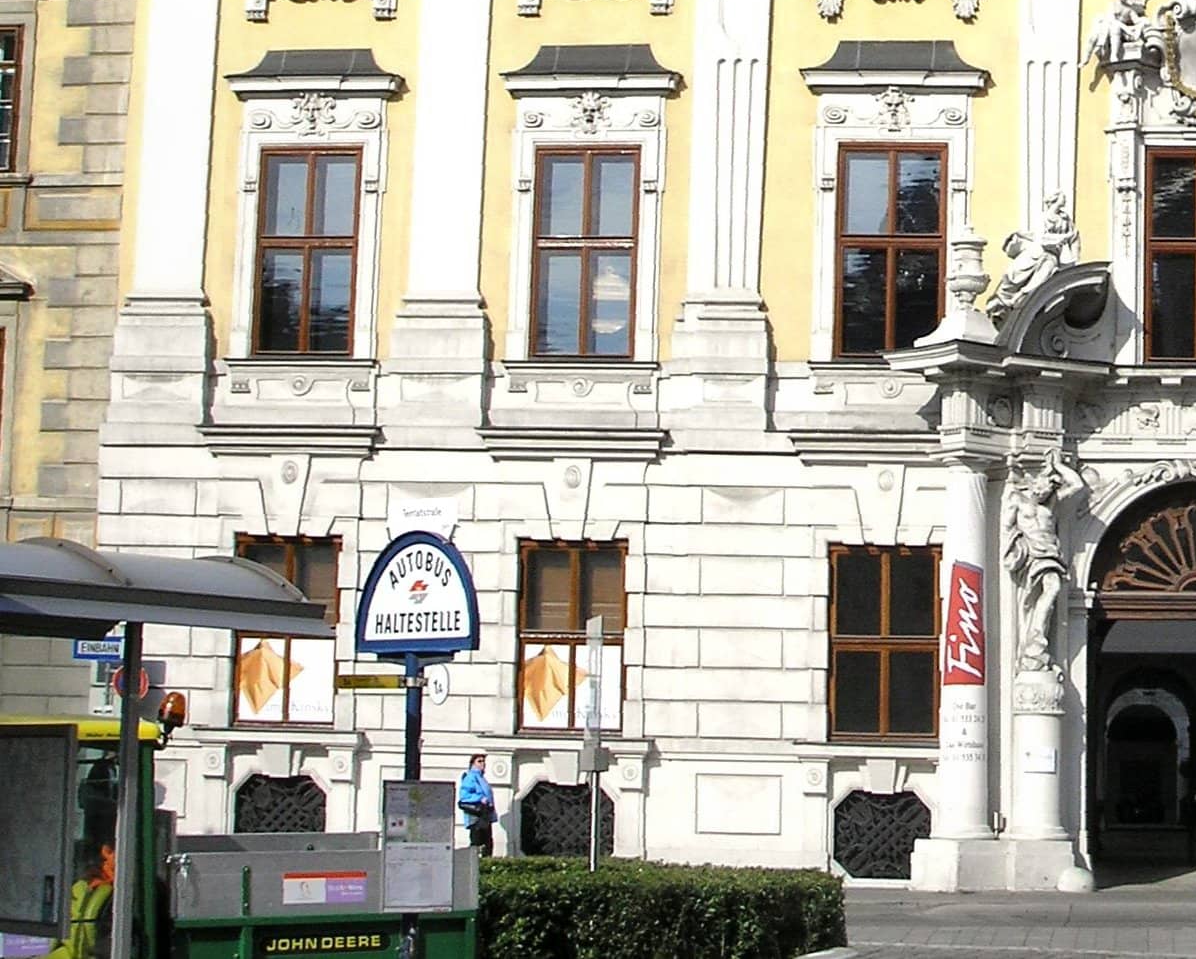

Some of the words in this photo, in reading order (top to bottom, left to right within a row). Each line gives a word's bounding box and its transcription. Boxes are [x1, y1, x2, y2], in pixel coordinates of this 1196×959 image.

[389, 550, 452, 590] AUTOBUS
[375, 610, 461, 634] HALTESTELLE
[947, 577, 983, 679] Fino
[81, 642, 120, 653] EINBAHN
[266, 938, 318, 952] JOHN
[321, 934, 381, 950] DEERE
